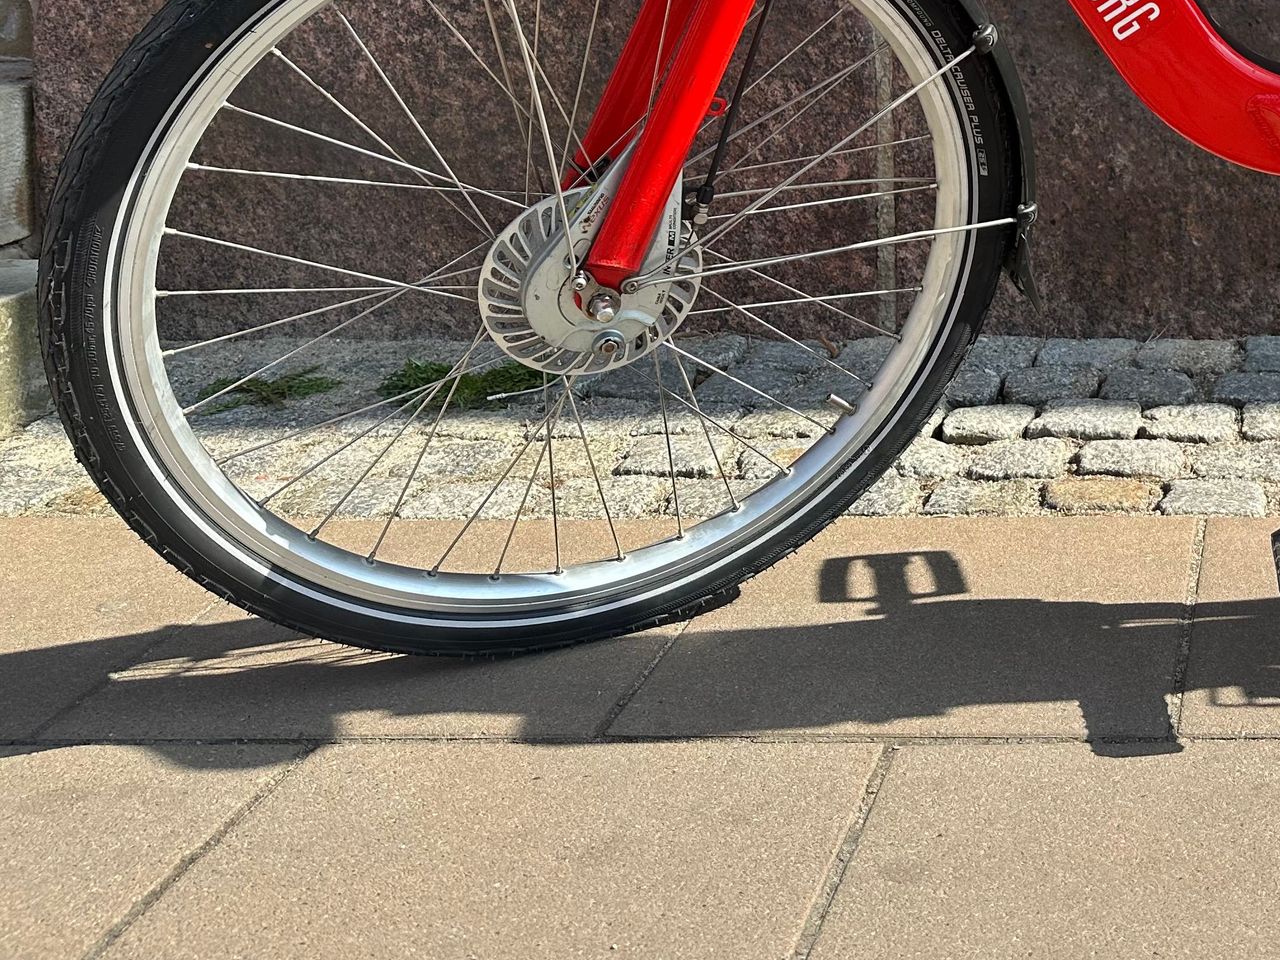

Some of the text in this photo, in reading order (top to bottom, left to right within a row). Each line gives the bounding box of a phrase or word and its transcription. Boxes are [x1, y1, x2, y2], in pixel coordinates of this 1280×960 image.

[931, 30, 955, 61] DELTA
[952, 65, 975, 111] CRUISER
[970, 115, 984, 144] PLUS
[663, 247, 675, 275] INER
